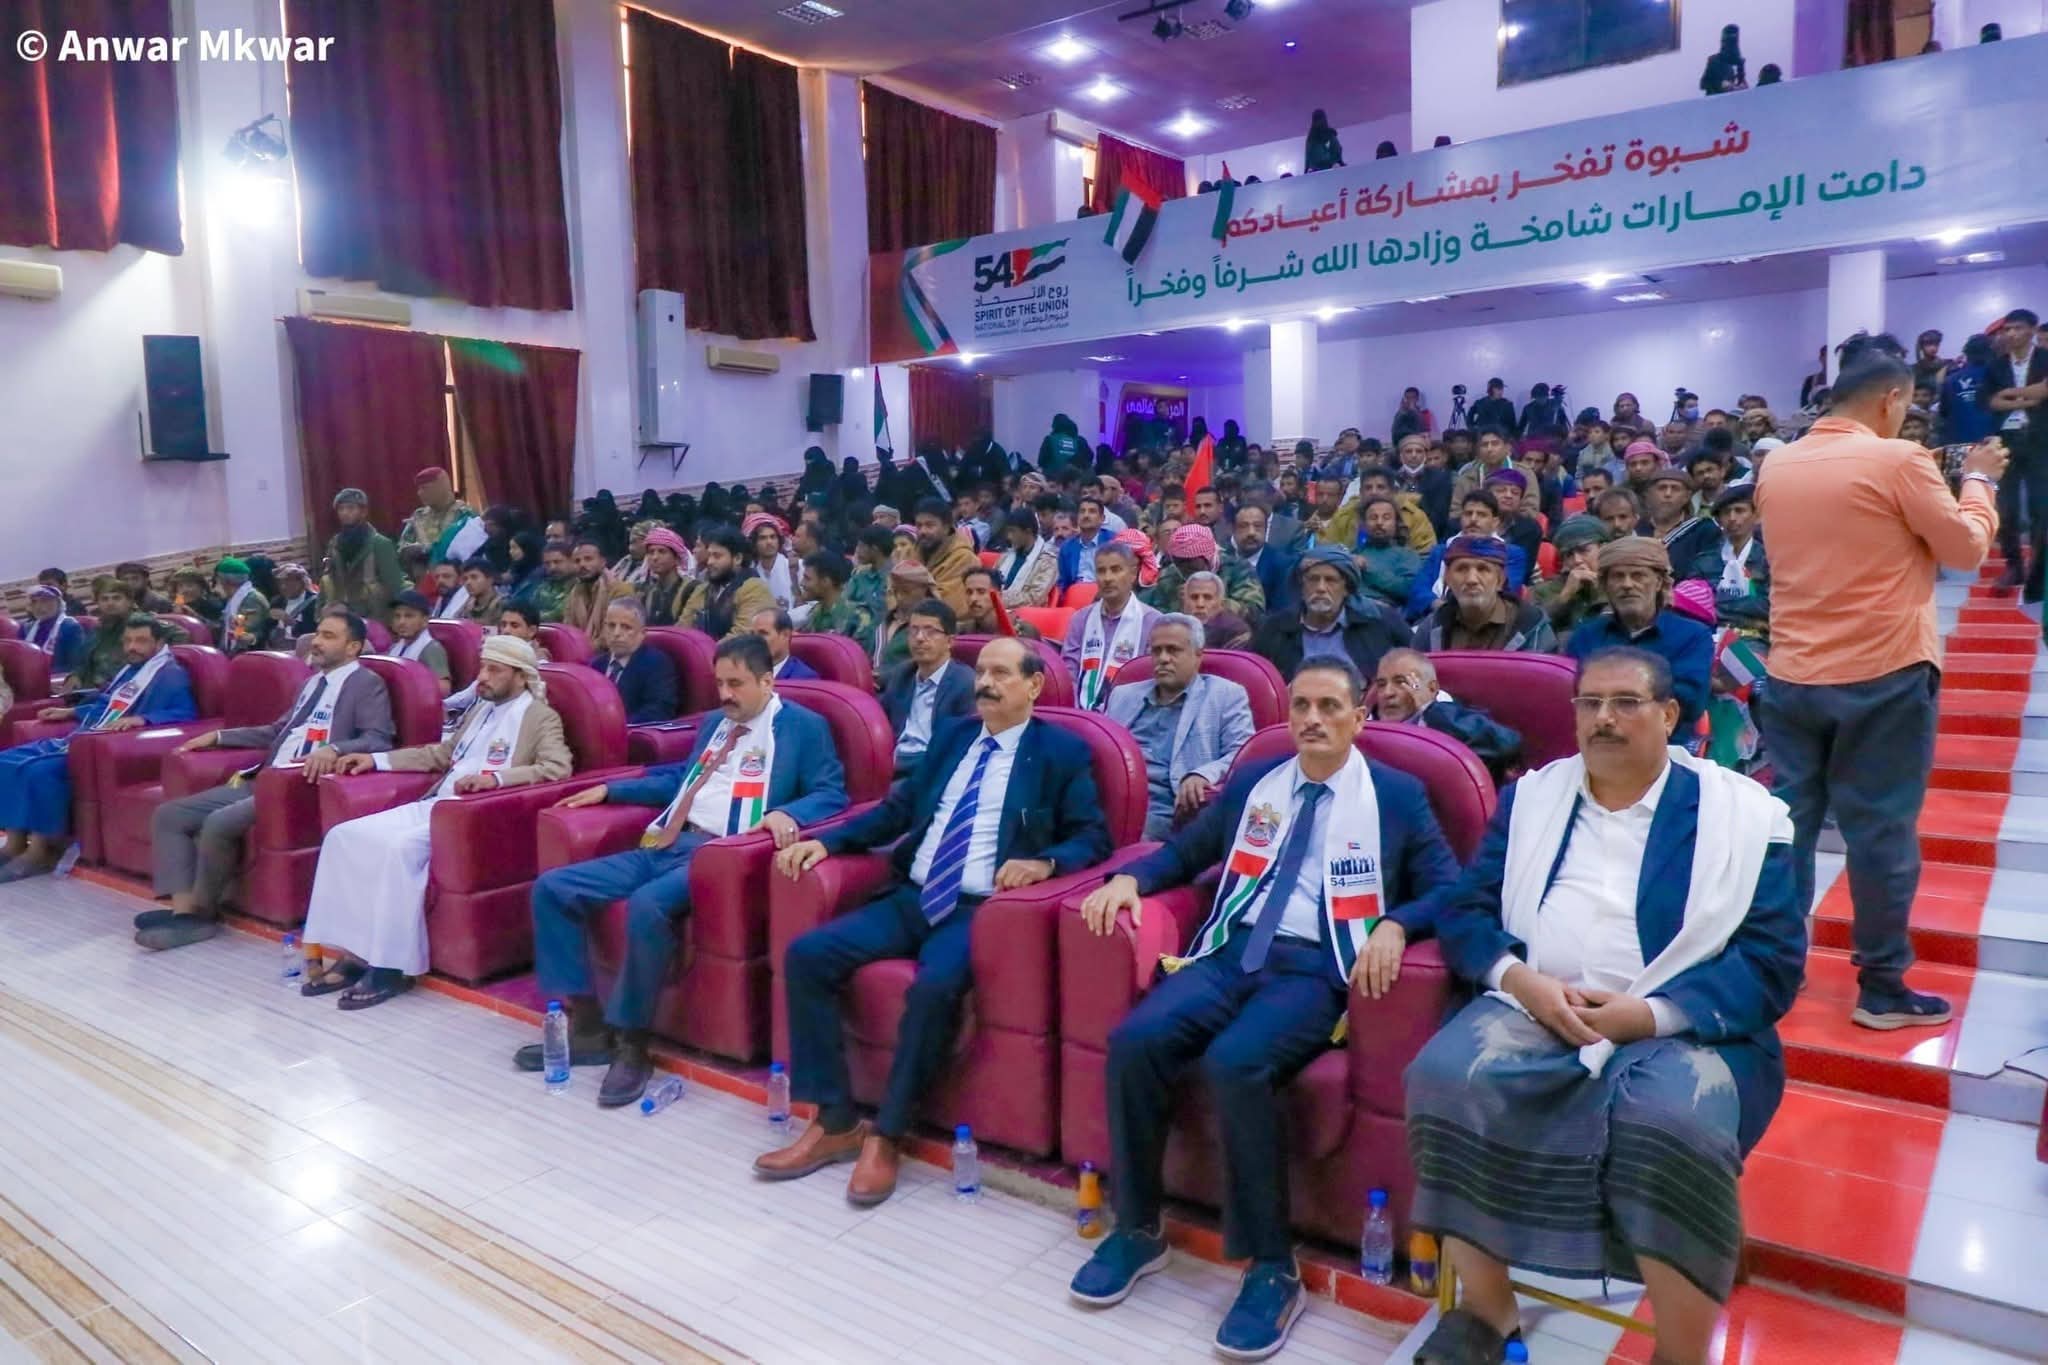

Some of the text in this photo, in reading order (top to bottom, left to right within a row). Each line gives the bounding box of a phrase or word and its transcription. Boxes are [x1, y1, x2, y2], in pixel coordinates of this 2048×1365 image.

[1220, 120, 1750, 249] شبوة تفخر بمشاركة أعيادكم
[1817, 159, 1927, 202] دامت
[1622, 173, 1806, 233] الإمارات
[1470, 202, 1613, 252] شامخة
[1311, 242, 1358, 275] الله
[1368, 229, 1462, 267] وزادها
[973, 250, 1015, 293] 54
[975, 299, 1069, 322] SPIRIT OF THE UNION
[1048, 285, 1069, 300] روح
[1330, 877, 1346, 887] 54
